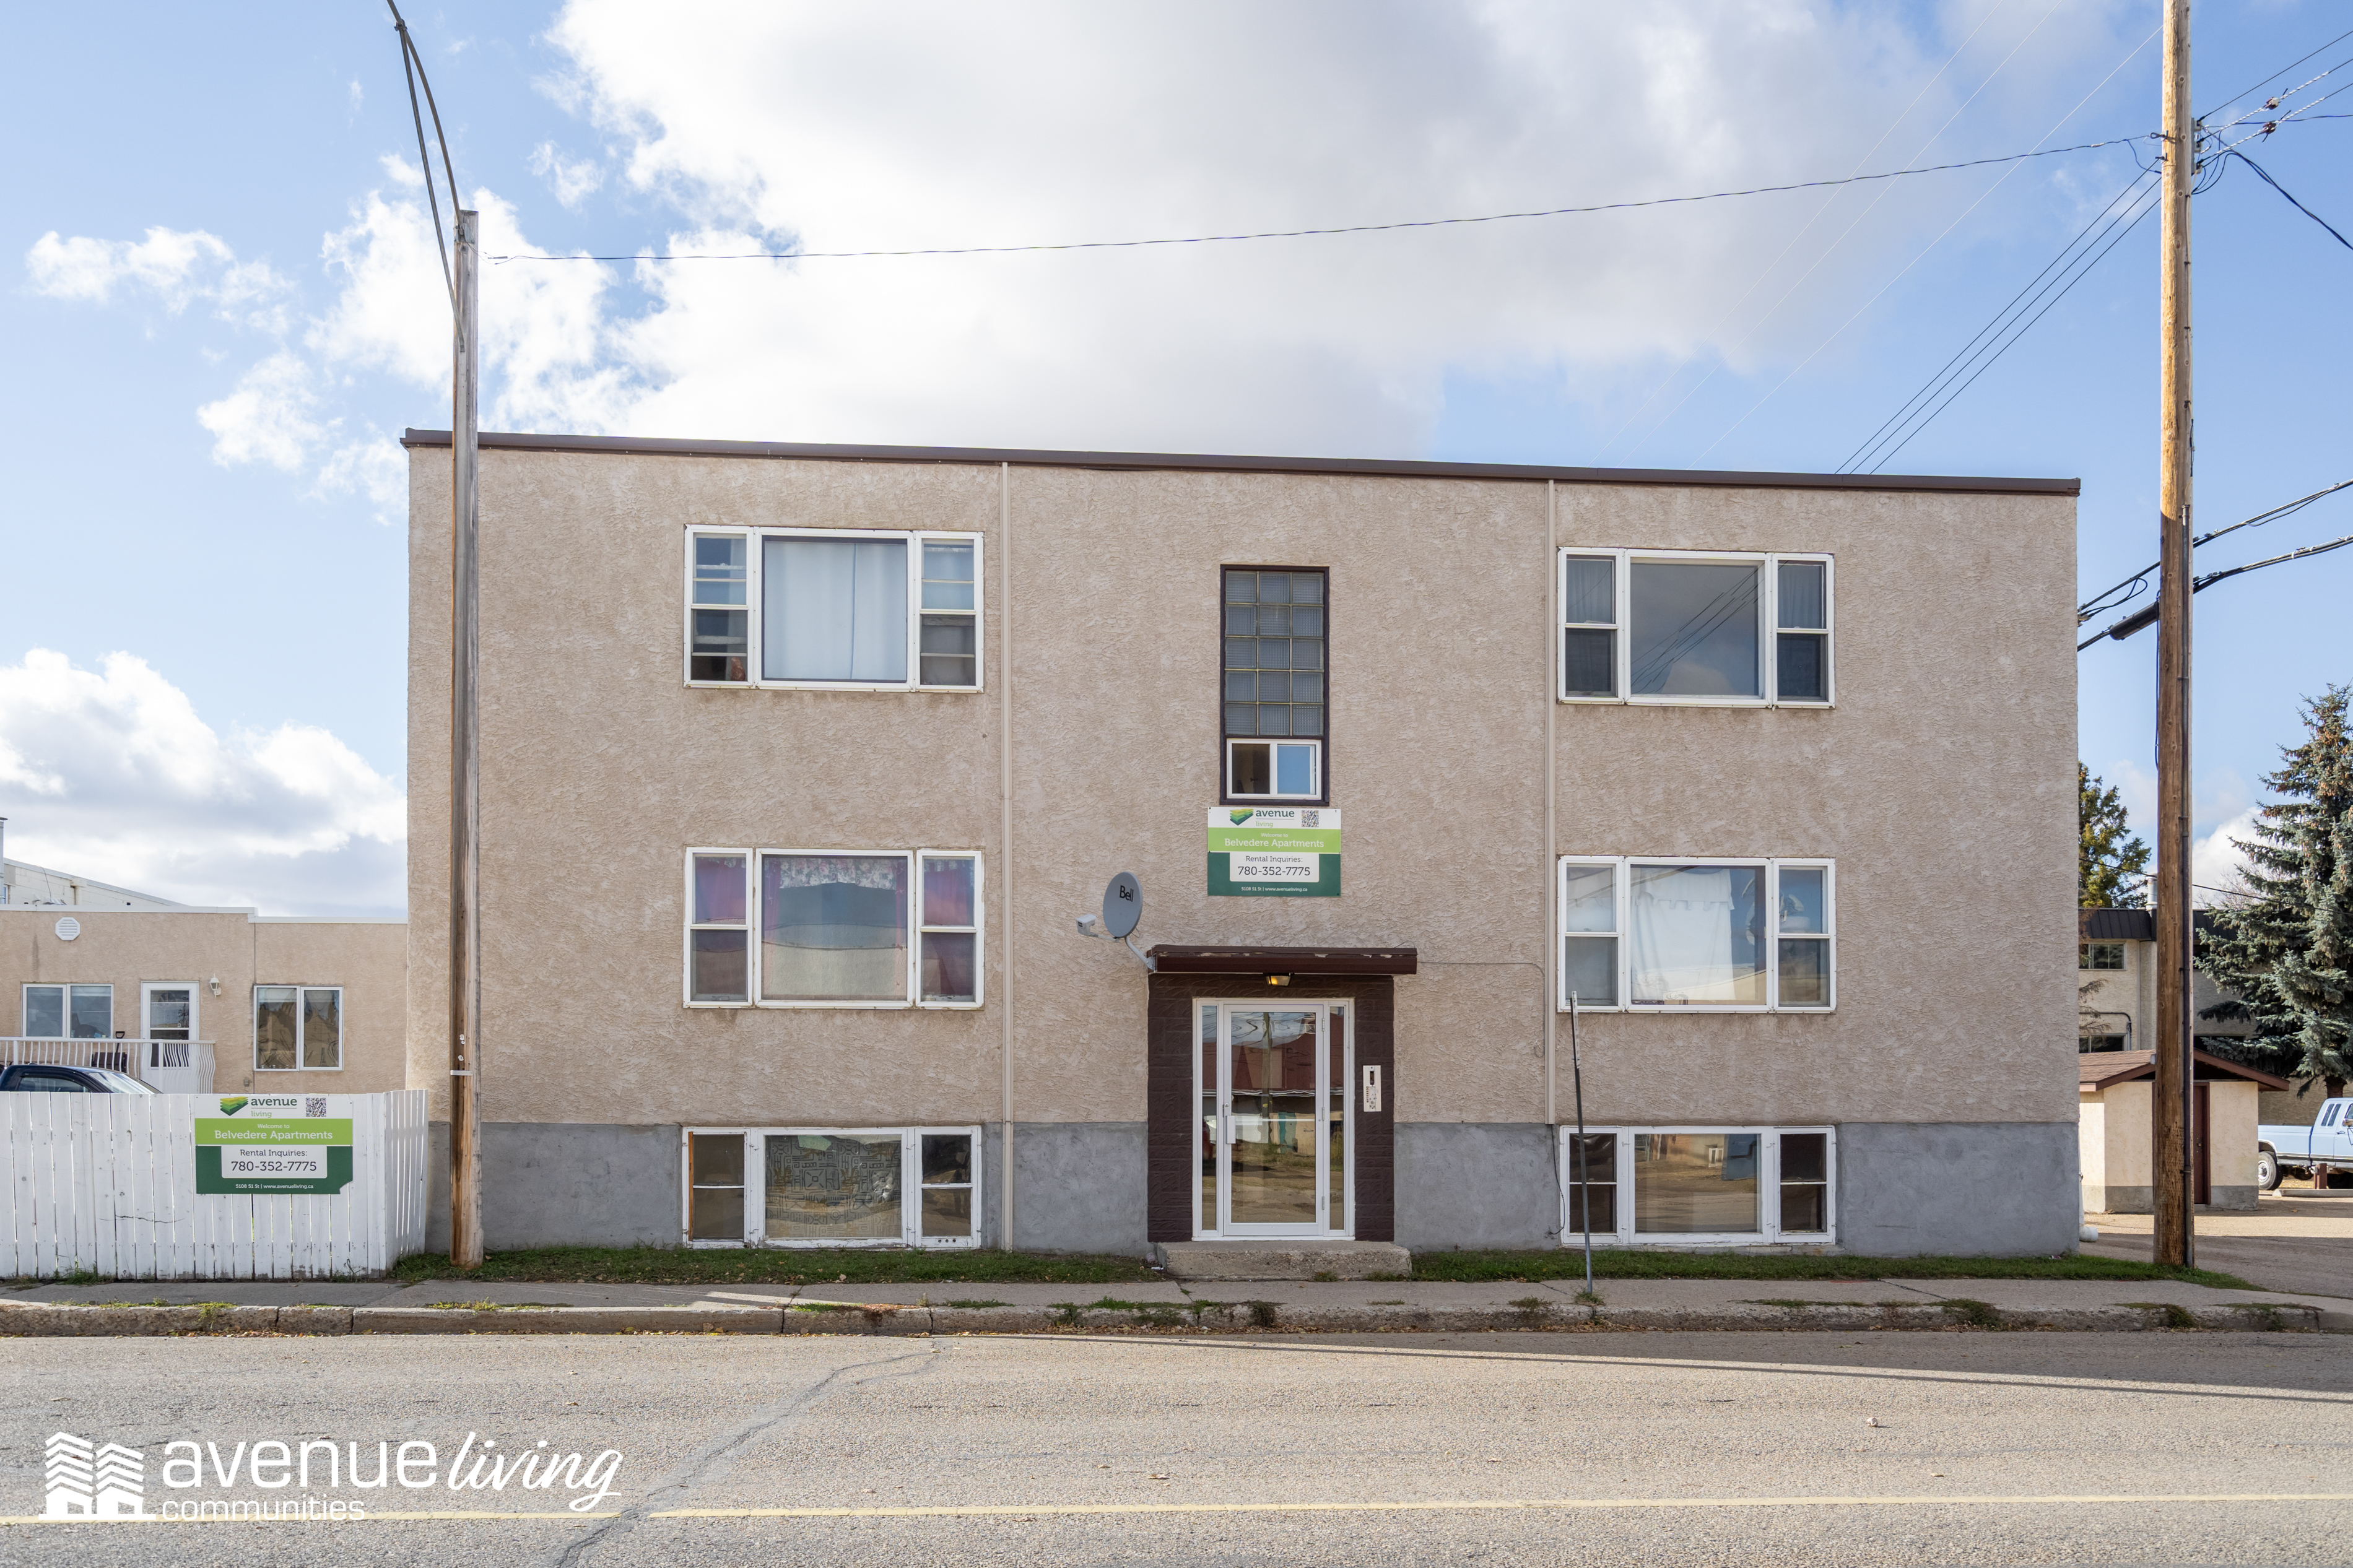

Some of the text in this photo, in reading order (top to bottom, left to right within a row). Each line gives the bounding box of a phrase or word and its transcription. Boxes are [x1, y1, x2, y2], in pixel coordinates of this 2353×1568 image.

[1225, 838, 1324, 848] Belvedere Apartments
[1238, 866, 1310, 876] 780-352-7775
[1120, 885, 1134, 902] Bell
[251, 1098, 297, 1106] avenue
[214, 1130, 333, 1141] Belvedere Apartments
[269, 1150, 308, 1158] Inquiries:
[231, 1161, 316, 1171] 780-352-7775
